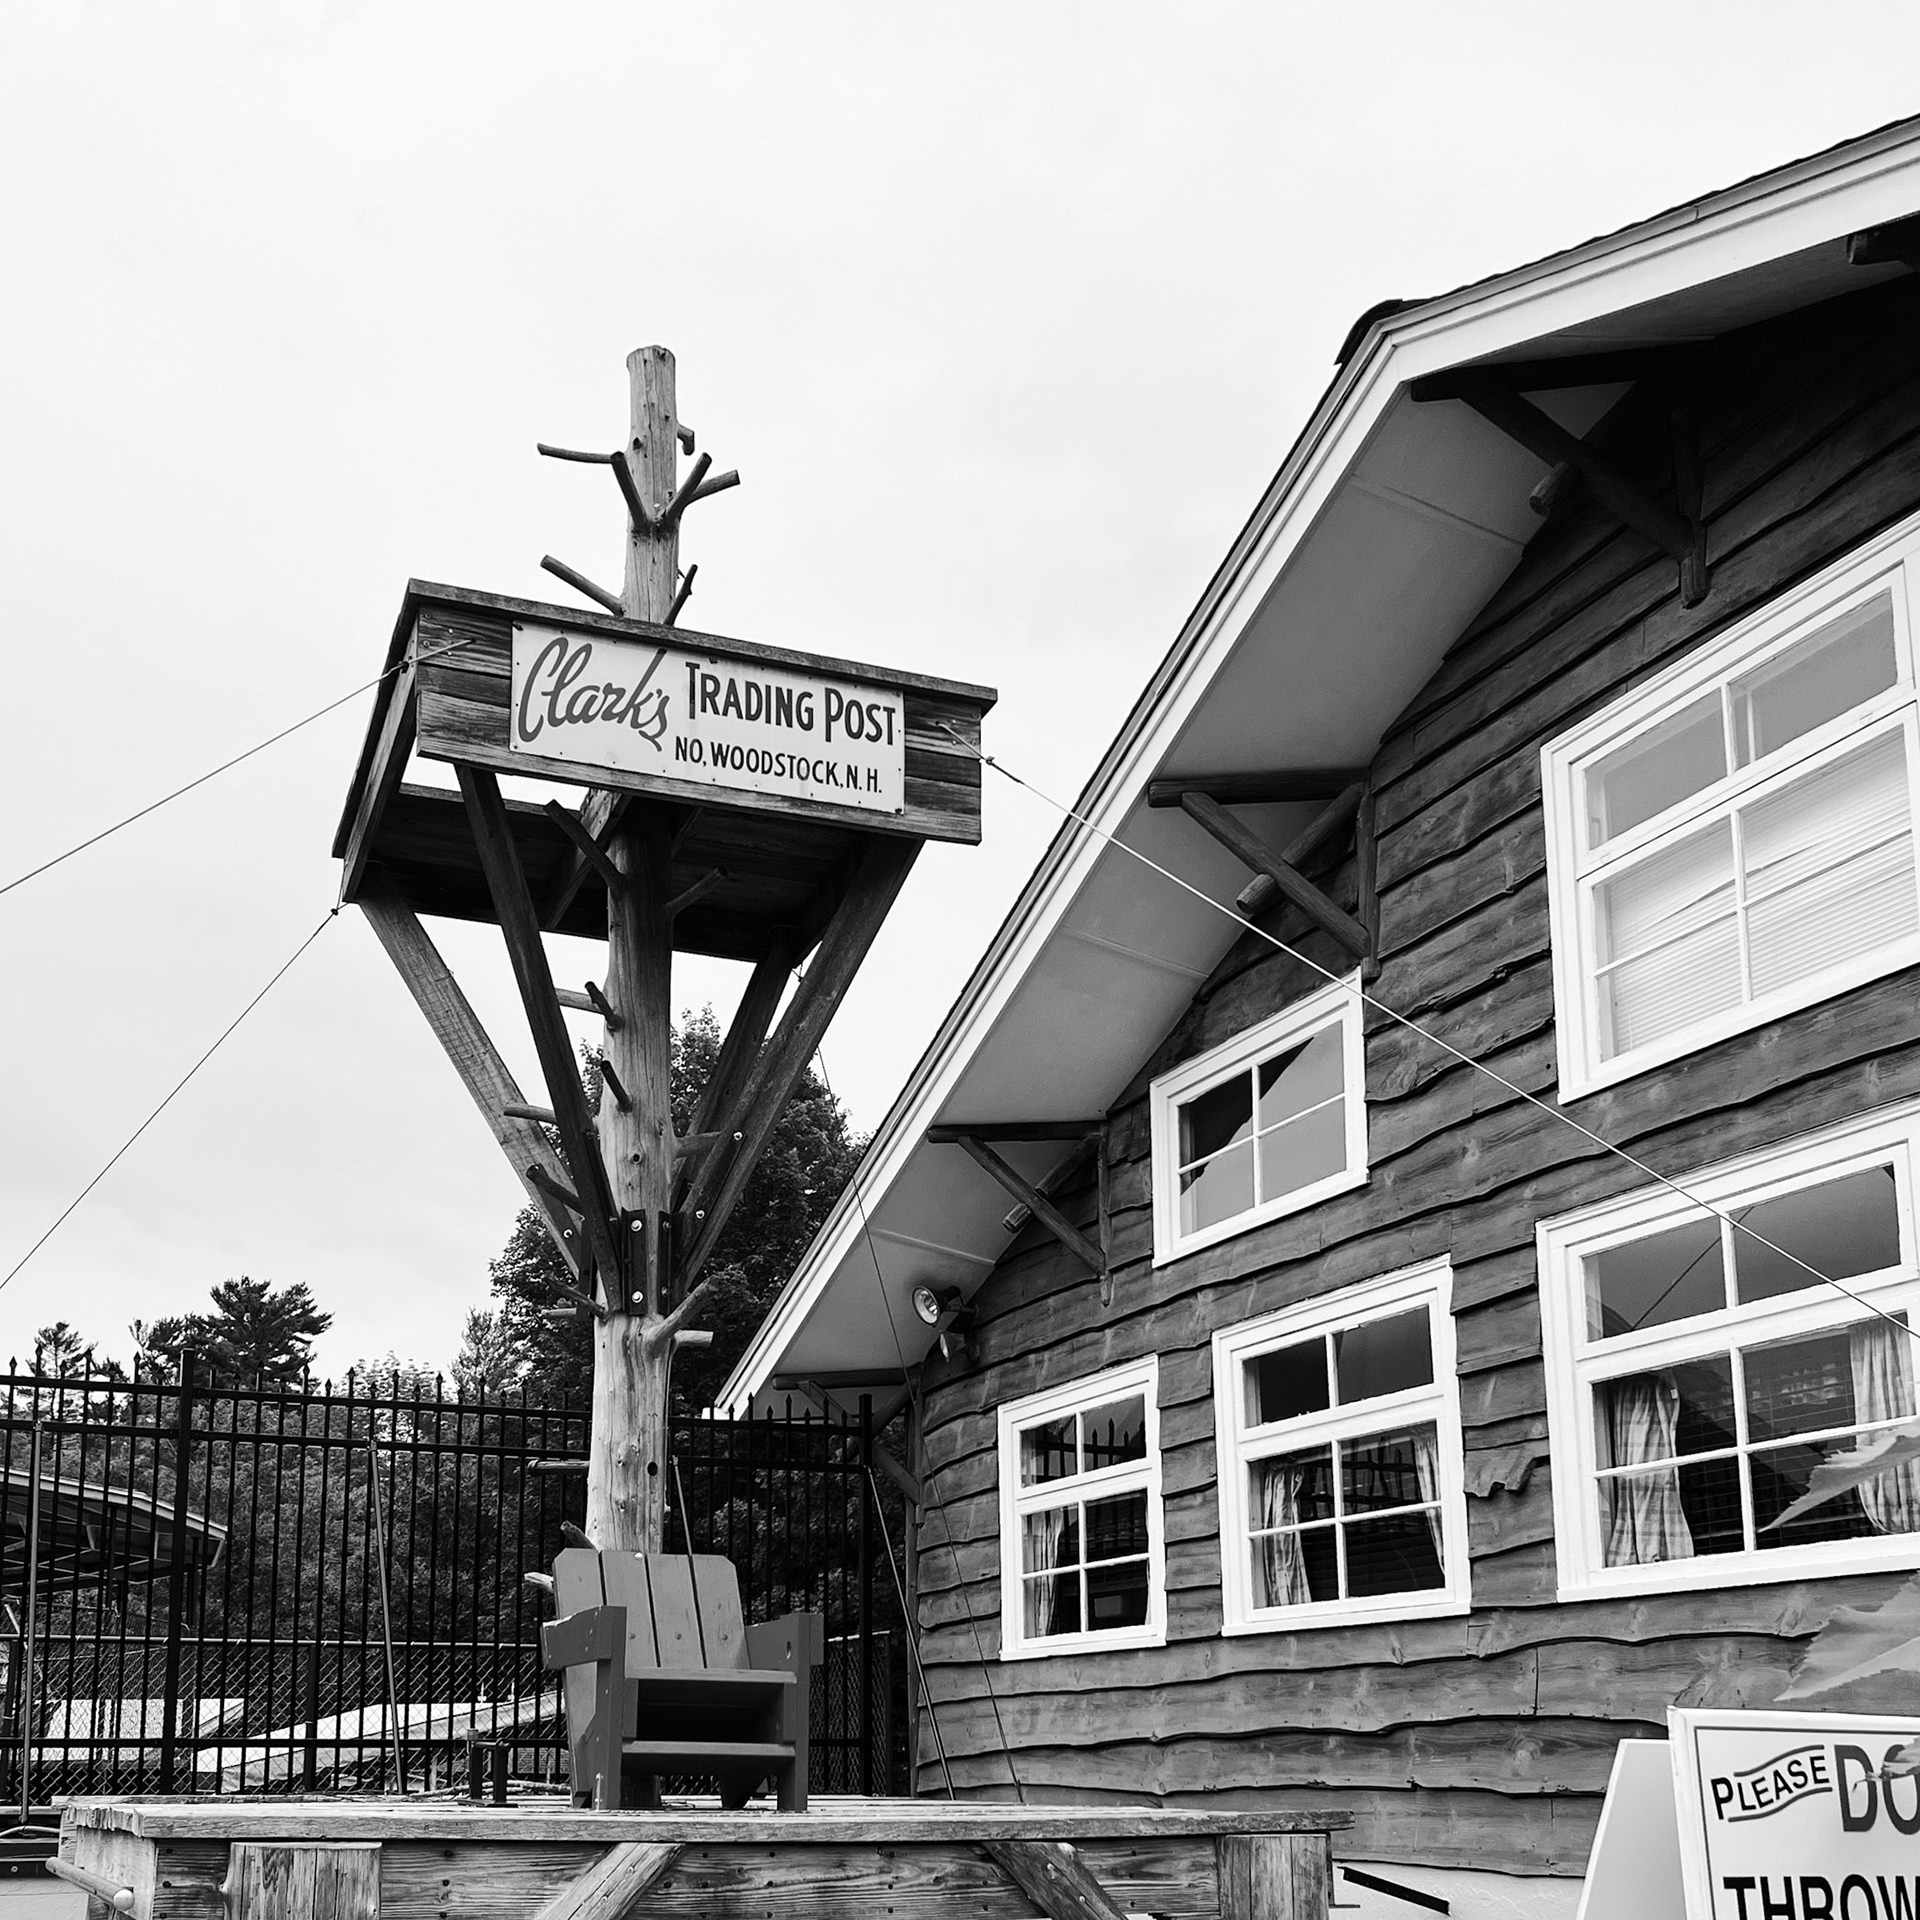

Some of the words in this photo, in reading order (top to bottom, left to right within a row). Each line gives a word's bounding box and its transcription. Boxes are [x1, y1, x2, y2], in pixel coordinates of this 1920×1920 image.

[518, 636, 670, 752] Clark's
[685, 661, 815, 732] TRADING
[824, 686, 896, 746] POST
[1711, 1755, 1830, 1820] PLEASE
